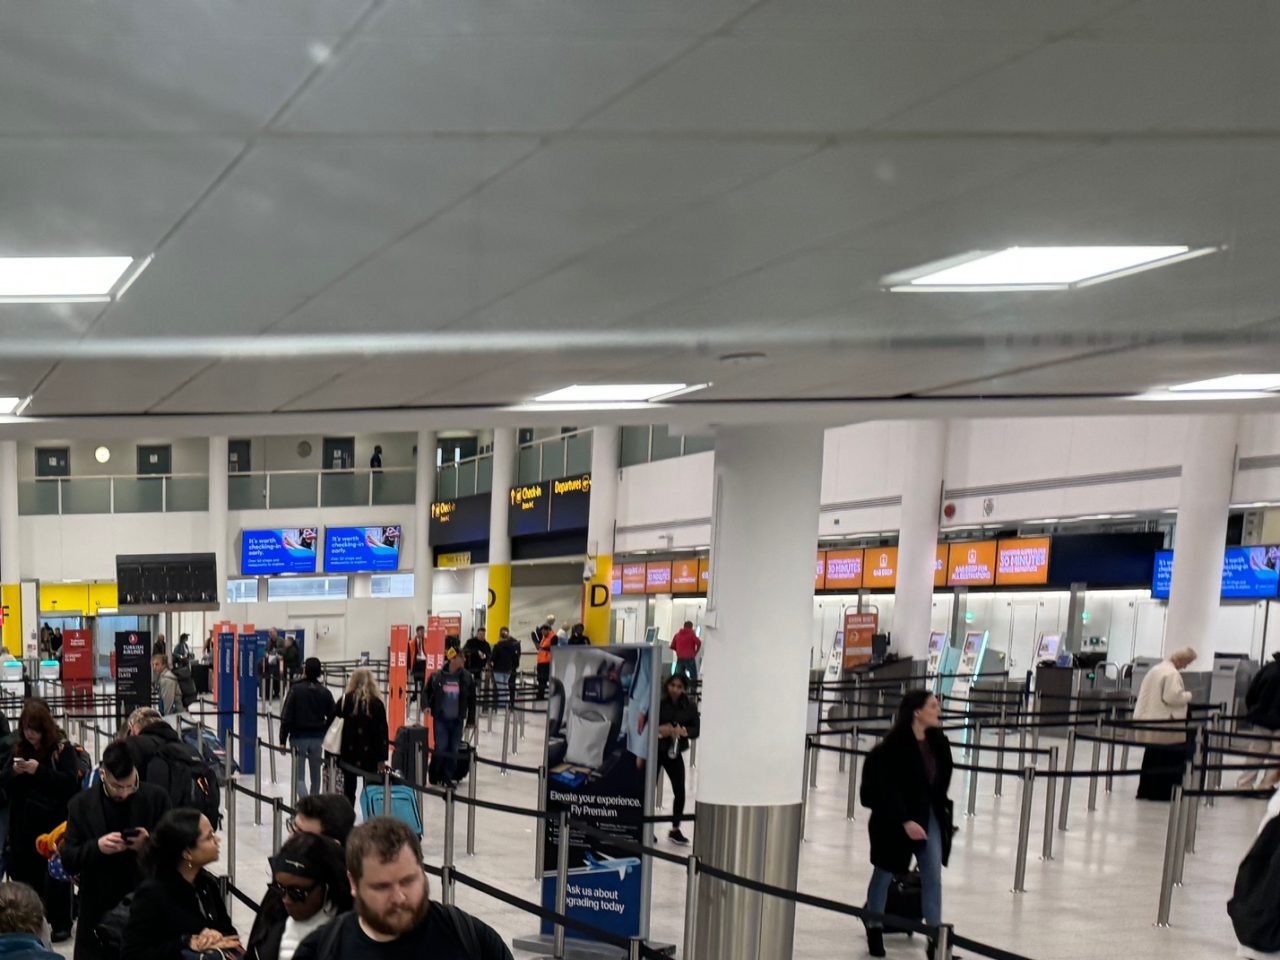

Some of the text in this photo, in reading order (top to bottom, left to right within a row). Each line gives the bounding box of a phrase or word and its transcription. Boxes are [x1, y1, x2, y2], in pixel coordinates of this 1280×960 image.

[522, 485, 542, 499] Check-in
[554, 479, 582, 495] Departures
[590, 584, 609, 608] D
[549, 790, 642, 808] Elevate your experience.
[570, 804, 618, 817] Fly Premium
[566, 883, 619, 900] Ask us about
[566, 896, 625, 914] grading today
